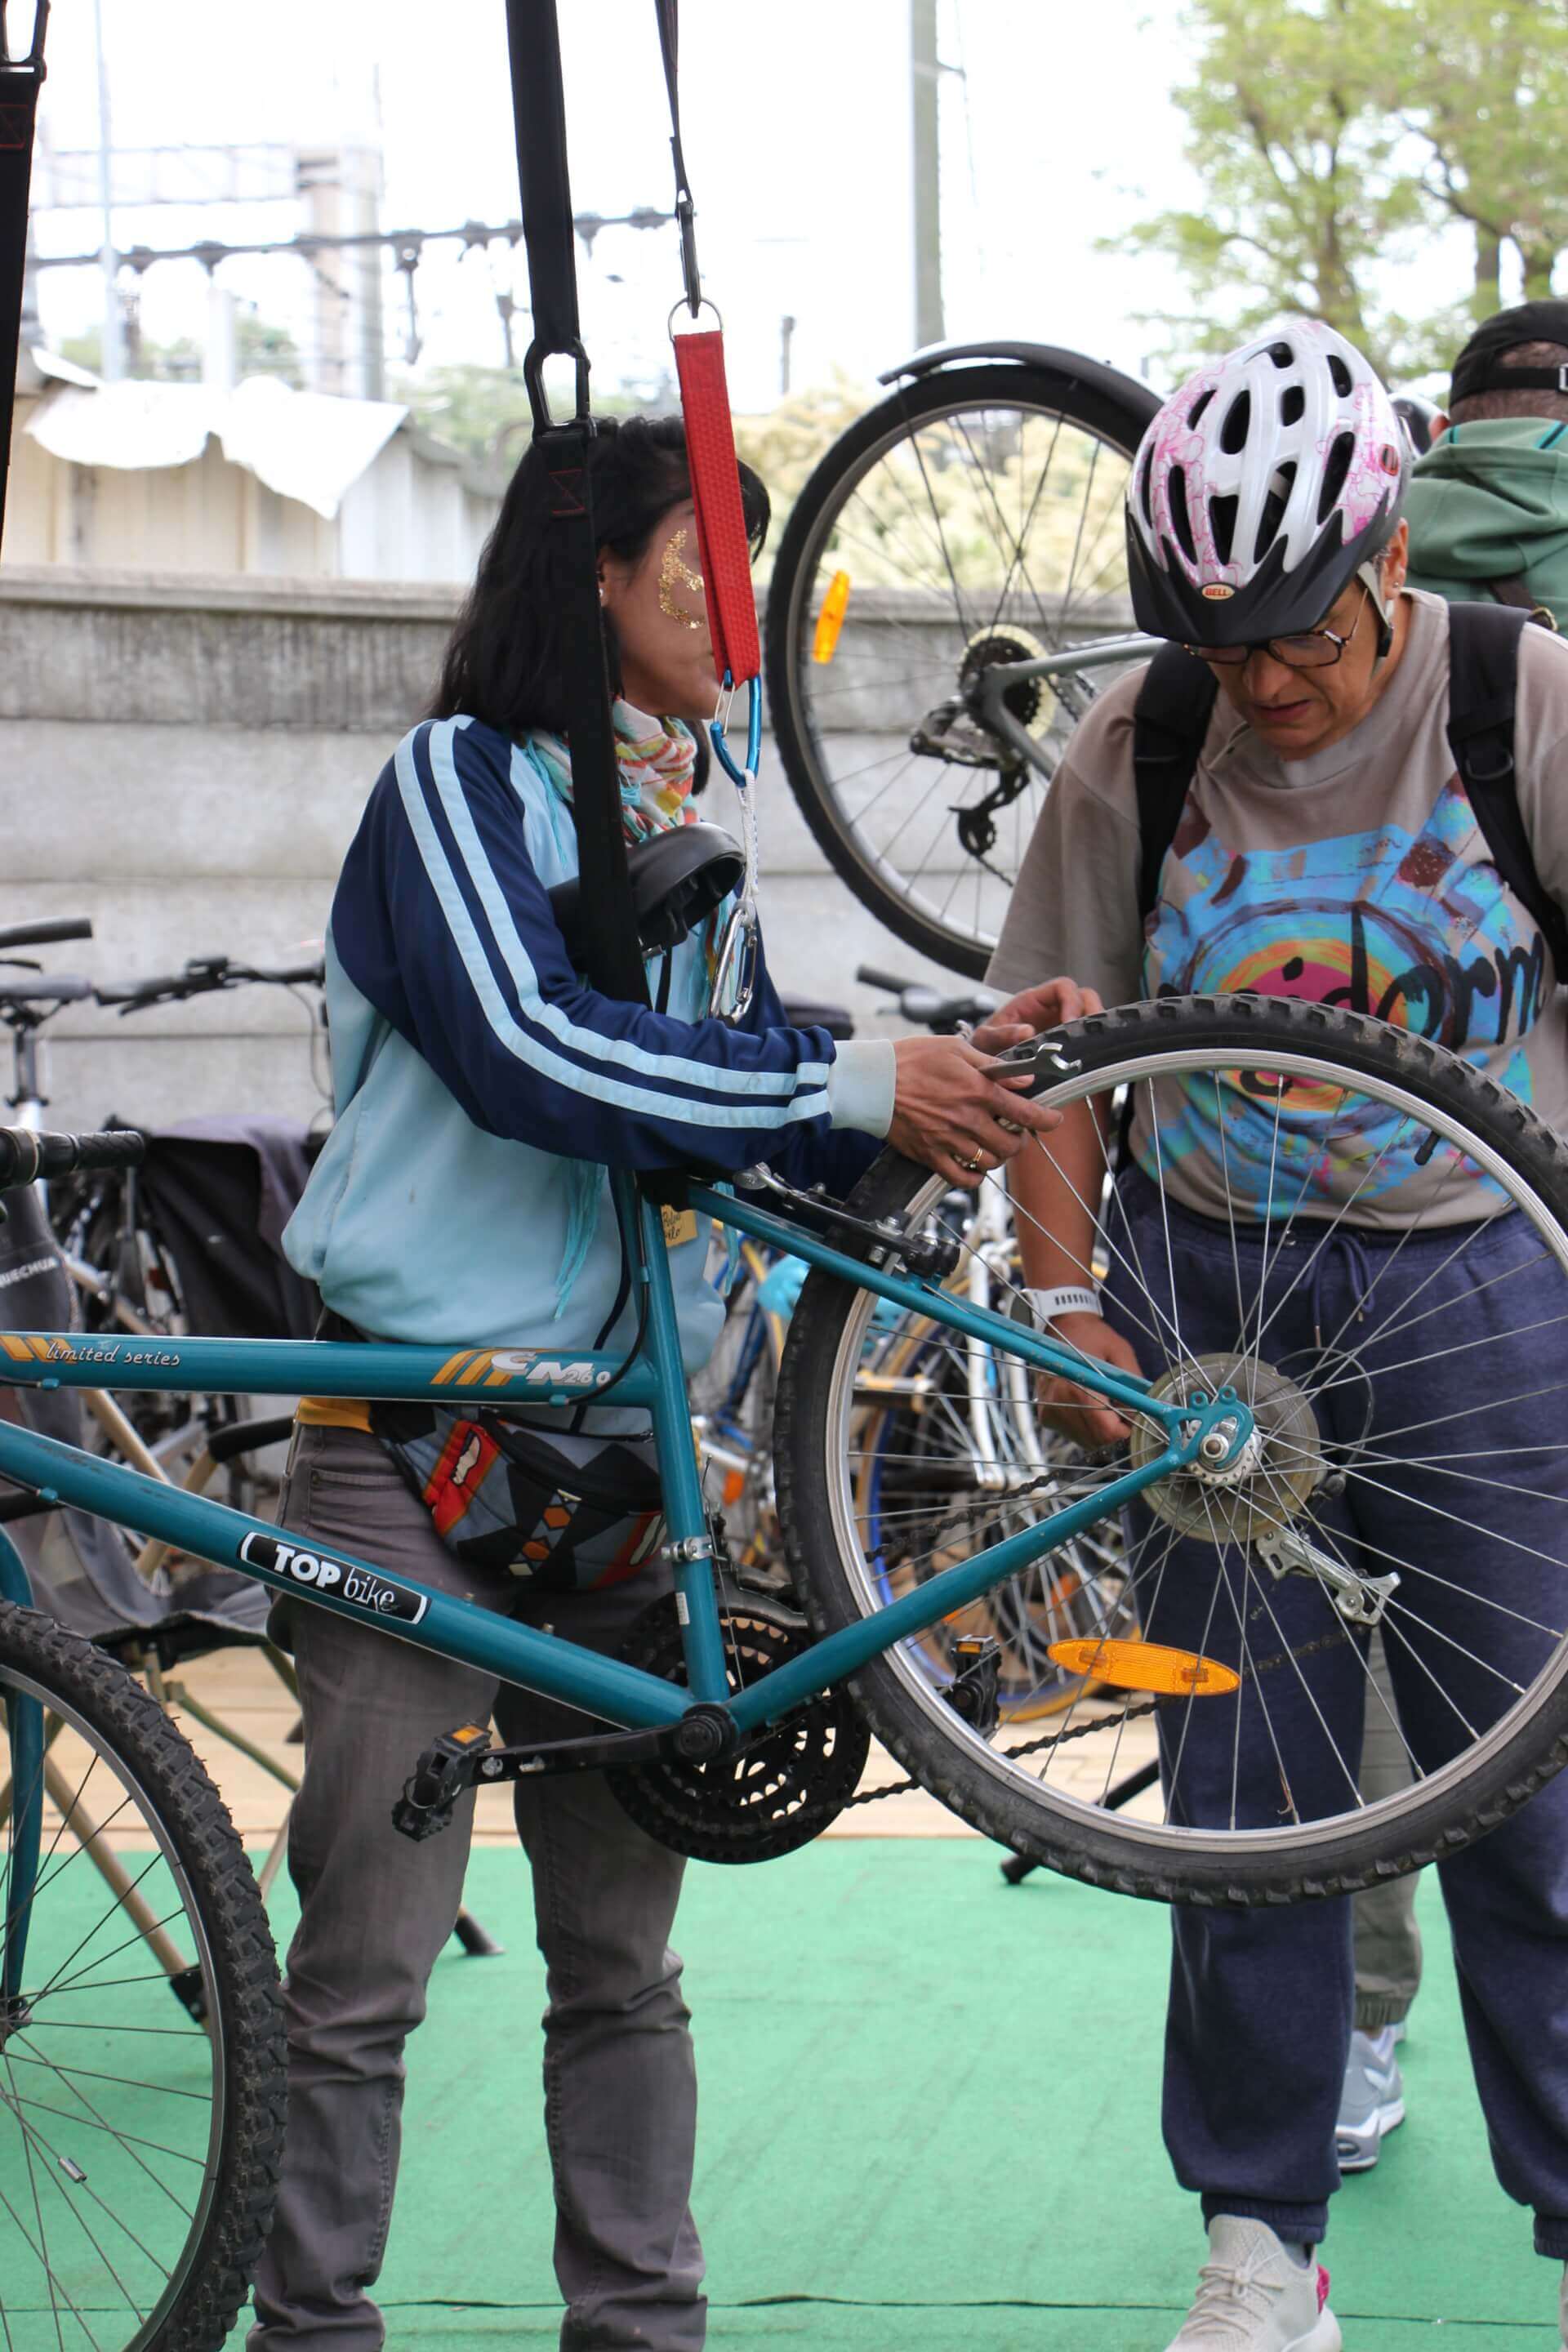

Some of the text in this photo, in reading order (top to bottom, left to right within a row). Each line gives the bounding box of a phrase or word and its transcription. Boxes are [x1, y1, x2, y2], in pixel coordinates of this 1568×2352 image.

[1205, 587, 1229, 596] BELL
[0, 1257, 57, 1289] UECHUA
[47, 1342, 181, 1366] limited series
[274, 1544, 397, 1612] TOP bike
